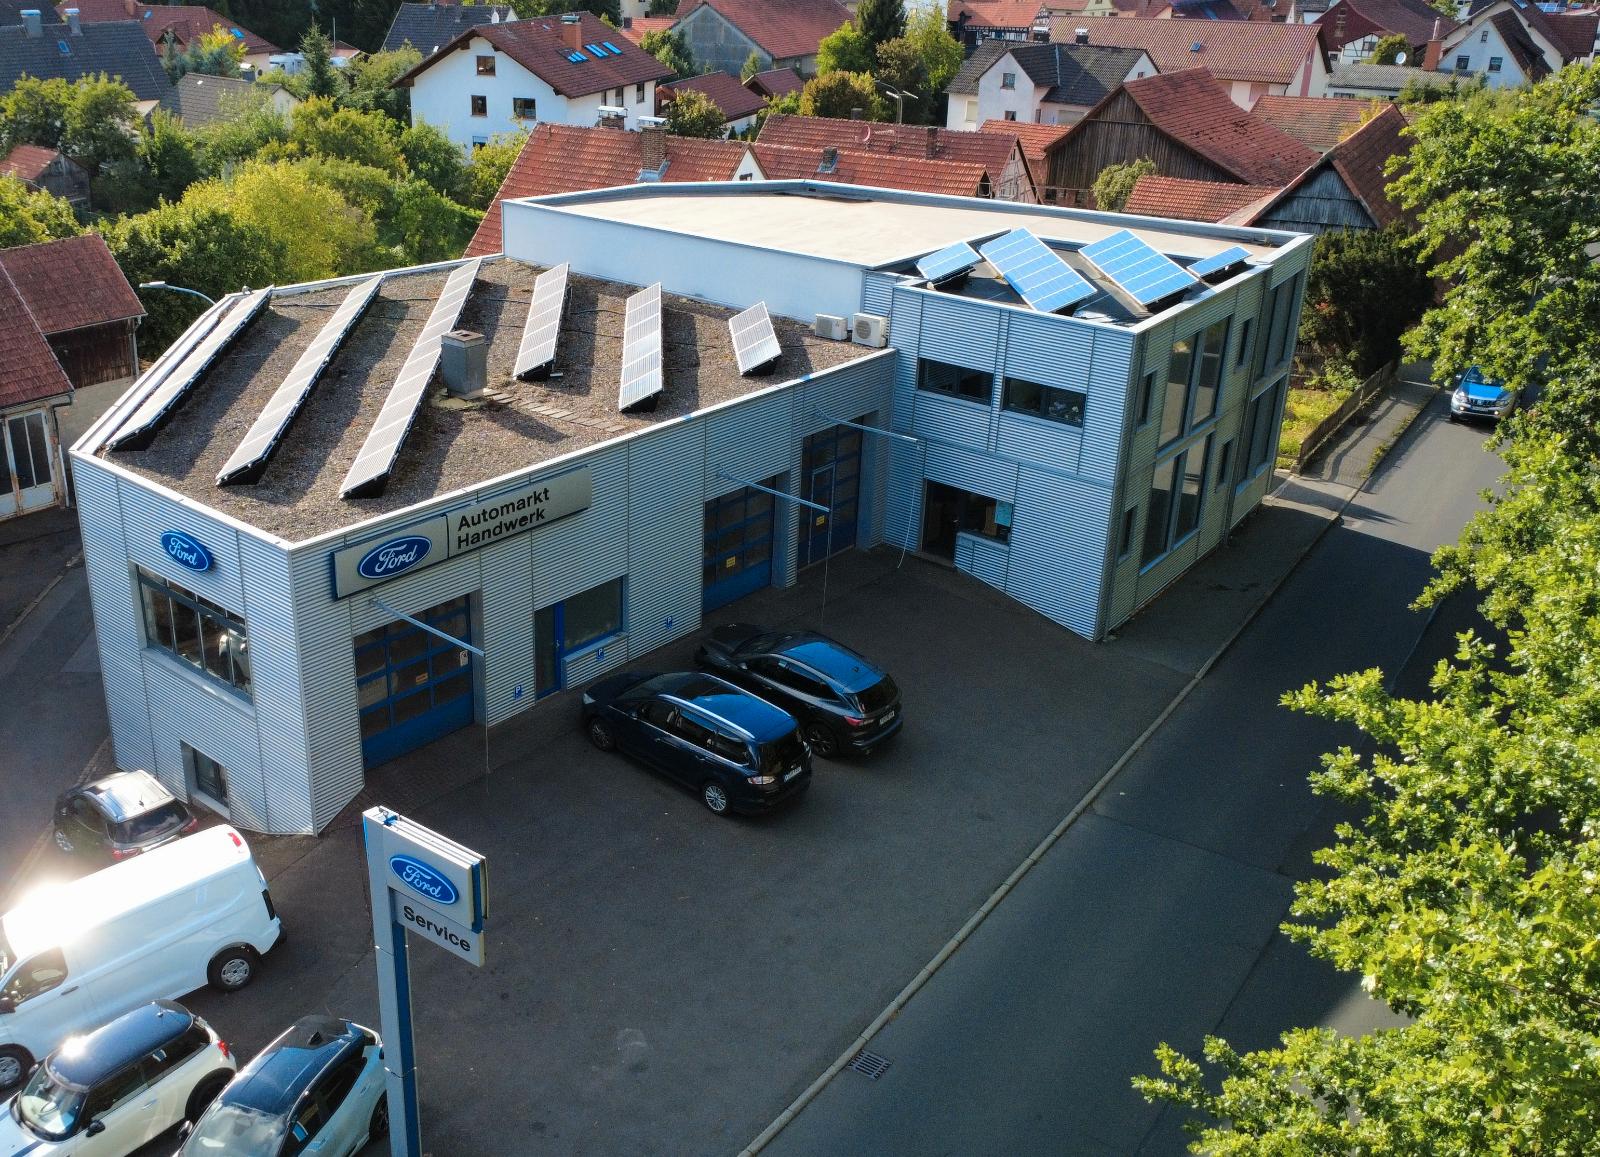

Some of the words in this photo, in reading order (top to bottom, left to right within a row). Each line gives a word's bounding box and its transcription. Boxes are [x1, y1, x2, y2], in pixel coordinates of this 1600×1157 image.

[457, 487, 550, 532] Automarkt
[457, 508, 546, 549] Handwerk
[169, 537, 198, 566] Ford
[374, 543, 418, 573] Ford
[402, 865, 442, 898] Ford
[403, 905, 471, 952] Service
